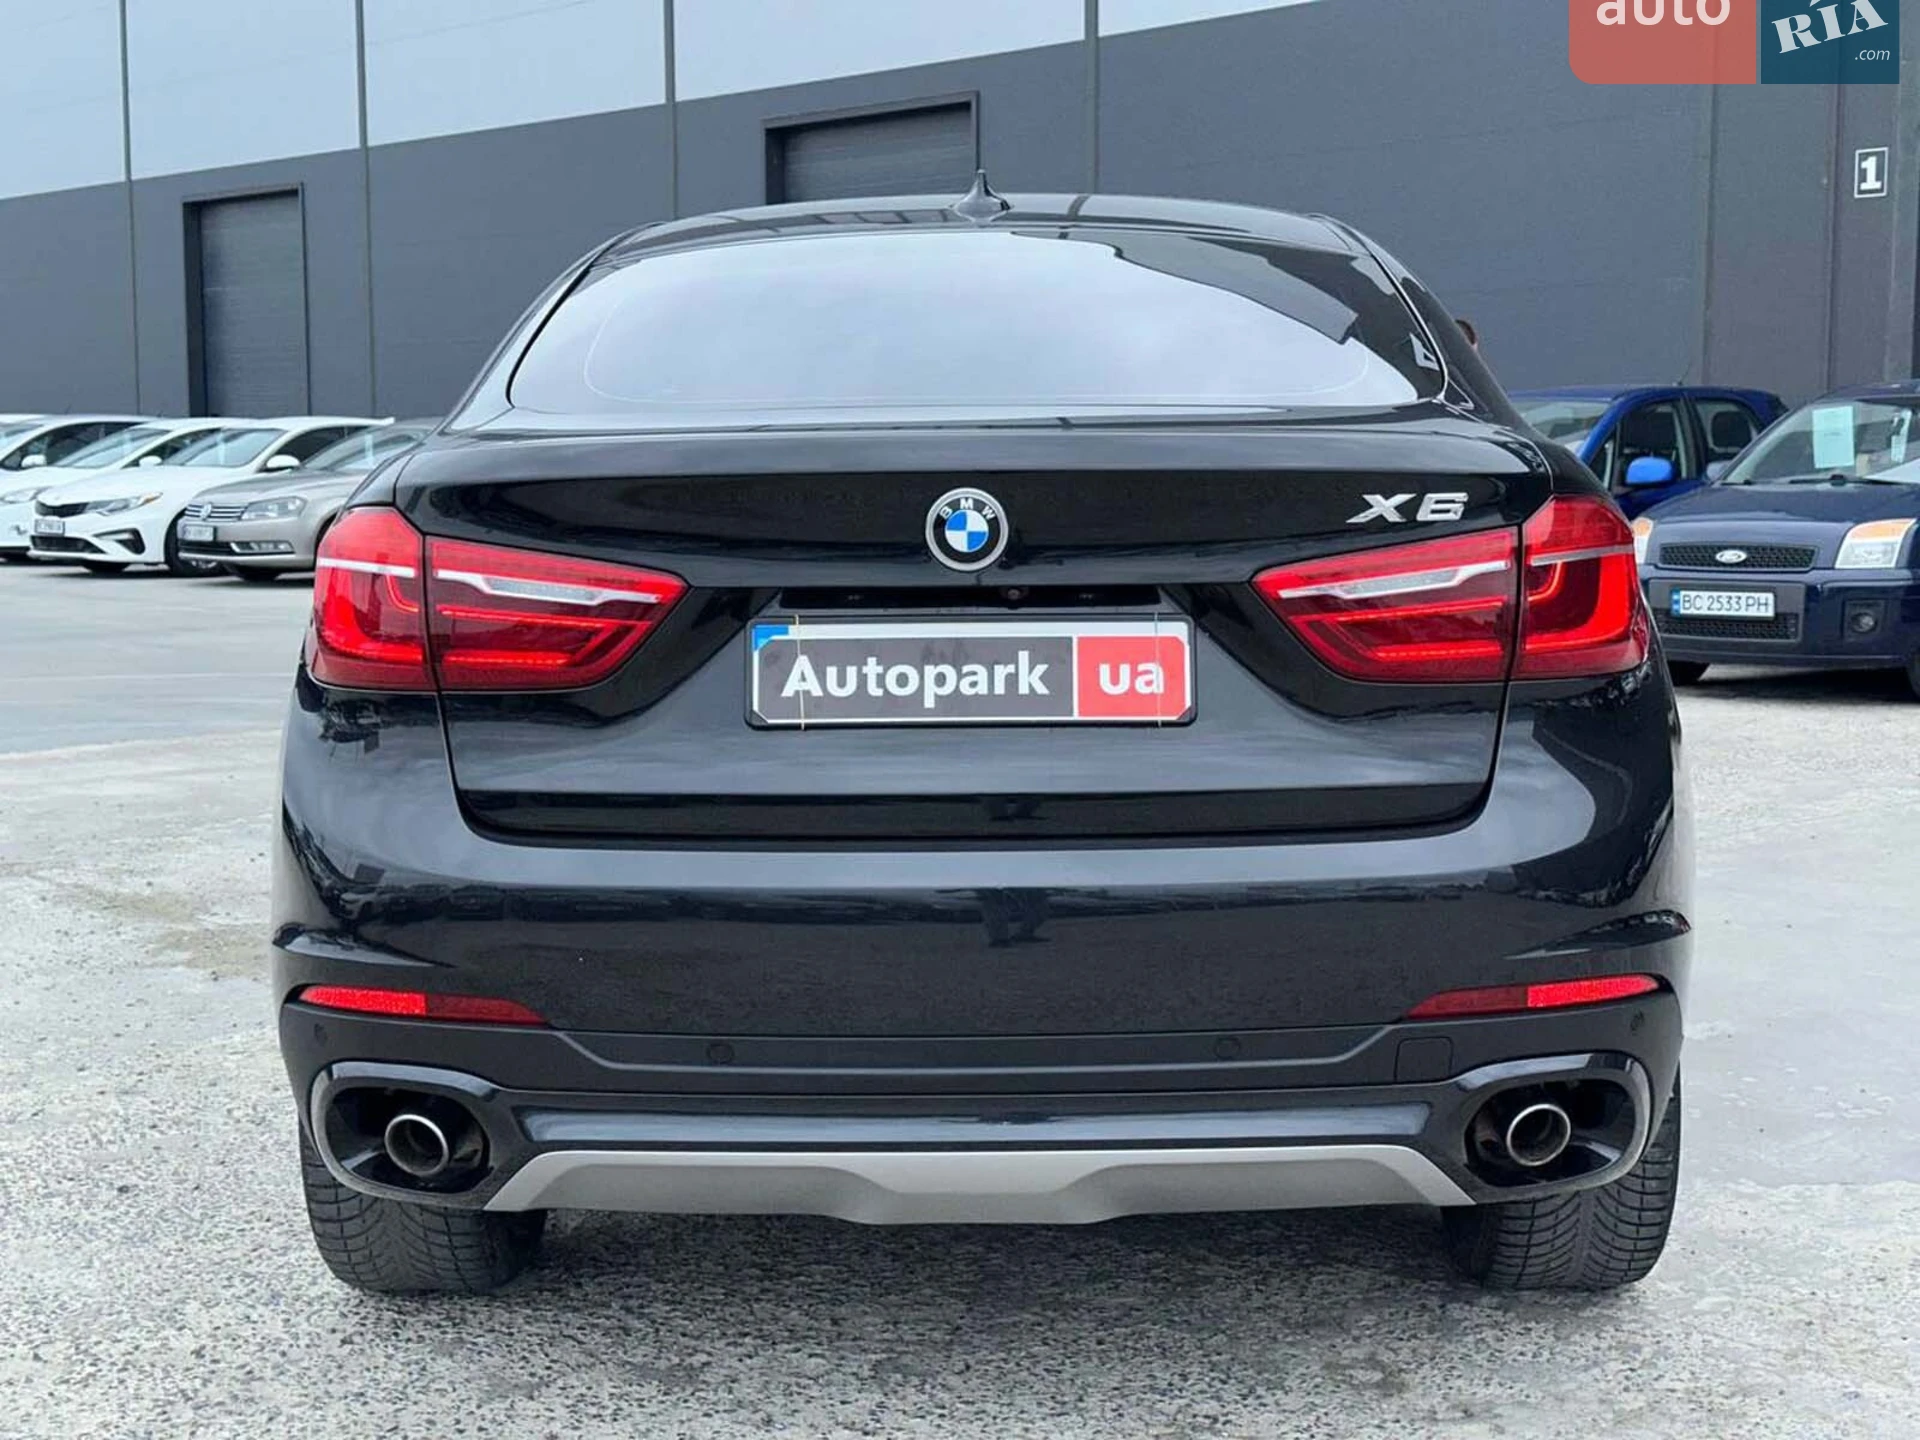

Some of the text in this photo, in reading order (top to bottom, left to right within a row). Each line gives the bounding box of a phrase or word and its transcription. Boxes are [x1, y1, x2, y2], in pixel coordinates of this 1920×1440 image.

[1859, 155, 1882, 191] 1
[939, 498, 996, 520] BMW
[1345, 492, 1469, 523] X6
[1682, 594, 1769, 613] BC 2533 PH
[781, 650, 1166, 708] Autopark ua
